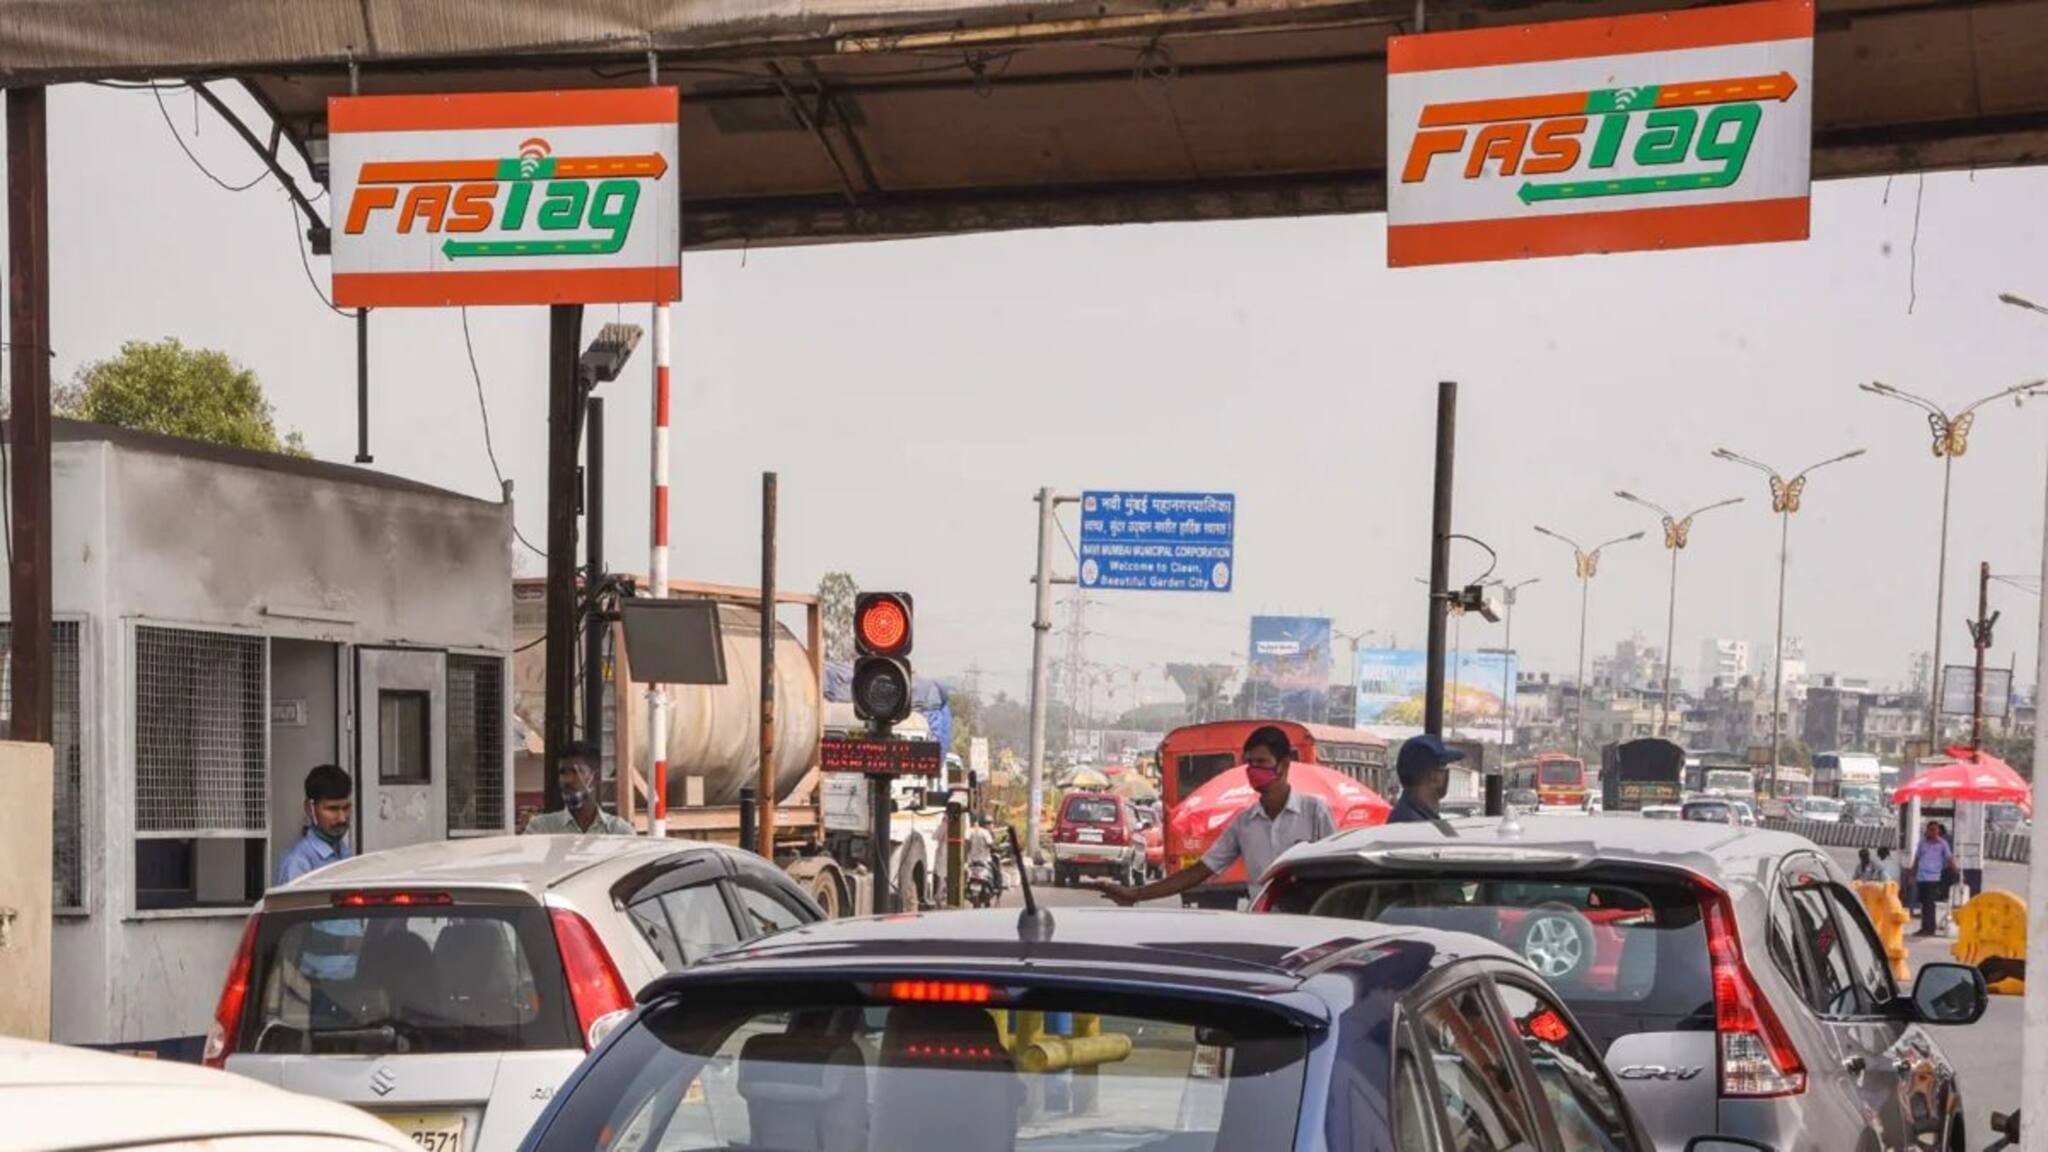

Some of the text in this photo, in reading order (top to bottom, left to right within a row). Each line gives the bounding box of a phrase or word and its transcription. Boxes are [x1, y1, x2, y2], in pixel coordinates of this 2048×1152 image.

[1102, 494, 1121, 512] नवी
[1125, 494, 1148, 516] मुंबई
[1102, 545, 1131, 555] MUMBAI
[1133, 546, 1173, 557] MUNICIPAL
[1175, 546, 1231, 558] CORPORATION
[1109, 561, 1202, 574] Welcome to Clean,
[1100, 574, 1209, 590] Beautiful Garden City
